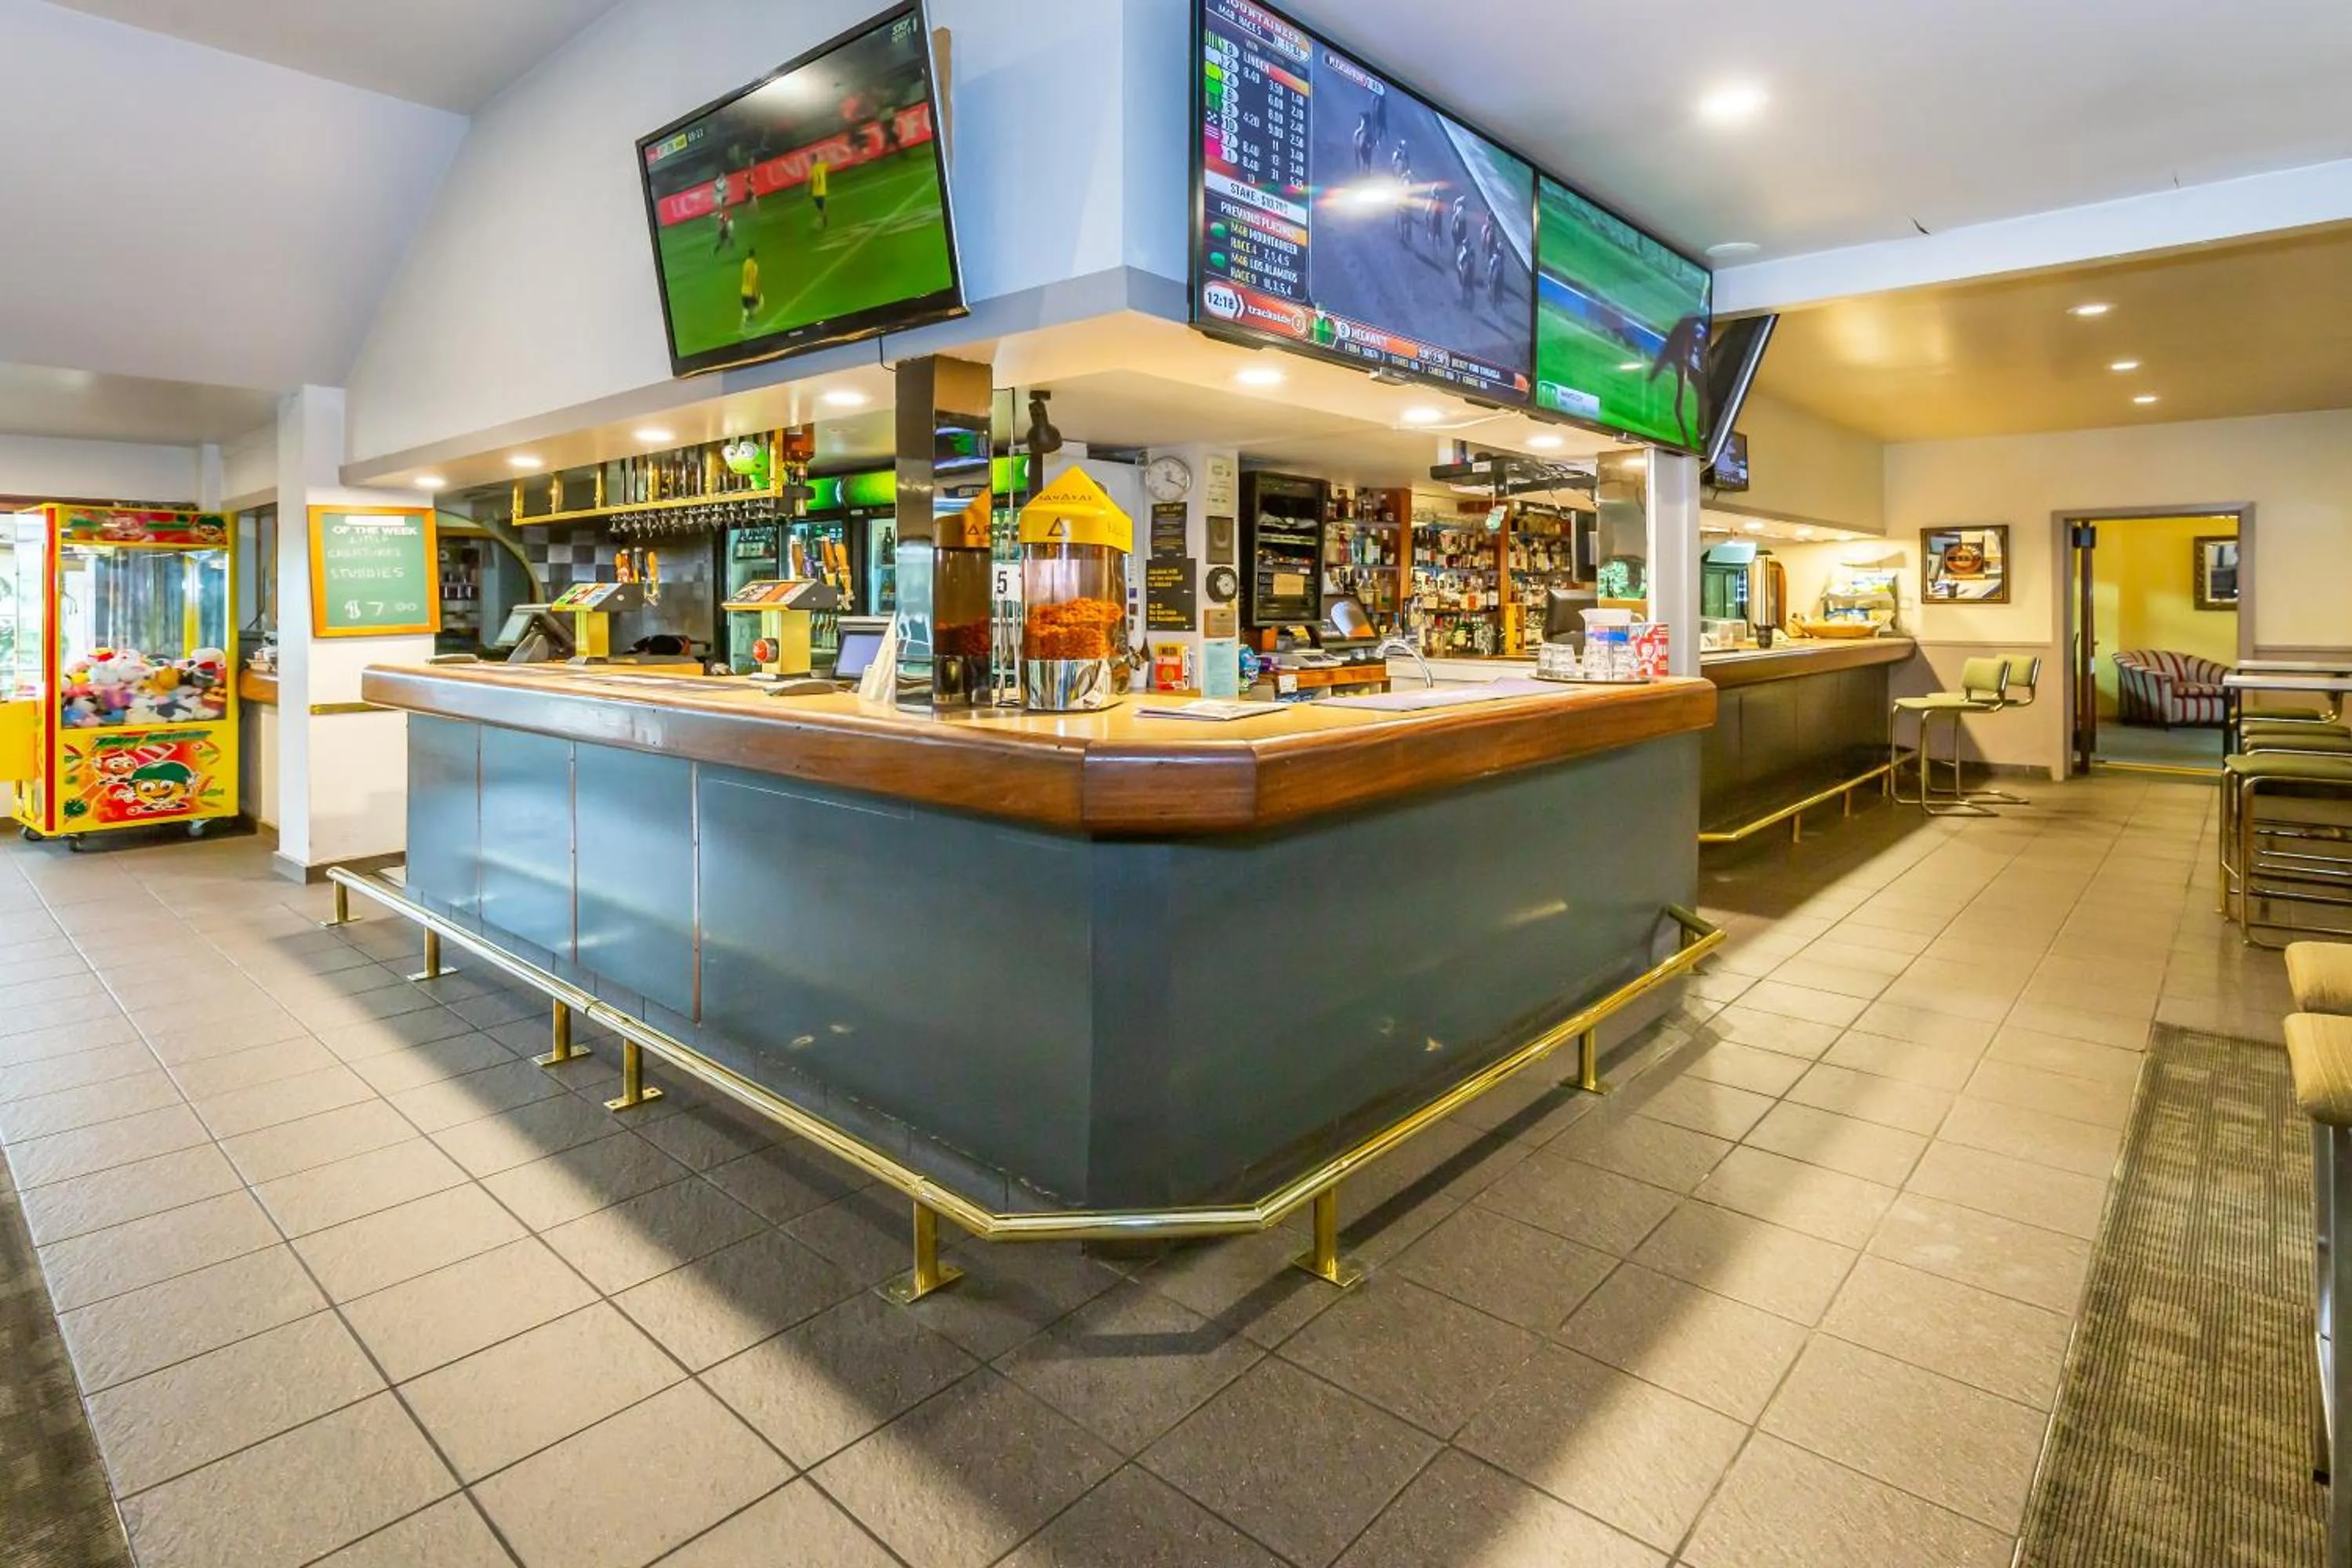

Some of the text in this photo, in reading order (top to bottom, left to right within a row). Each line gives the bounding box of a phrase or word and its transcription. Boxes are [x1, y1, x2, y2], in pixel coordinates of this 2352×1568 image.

[1221, 201, 1261, 227] PREVIOUS
[1207, 291, 1234, 310] 12:18
[332, 526, 419, 536] OF THE WEEK
